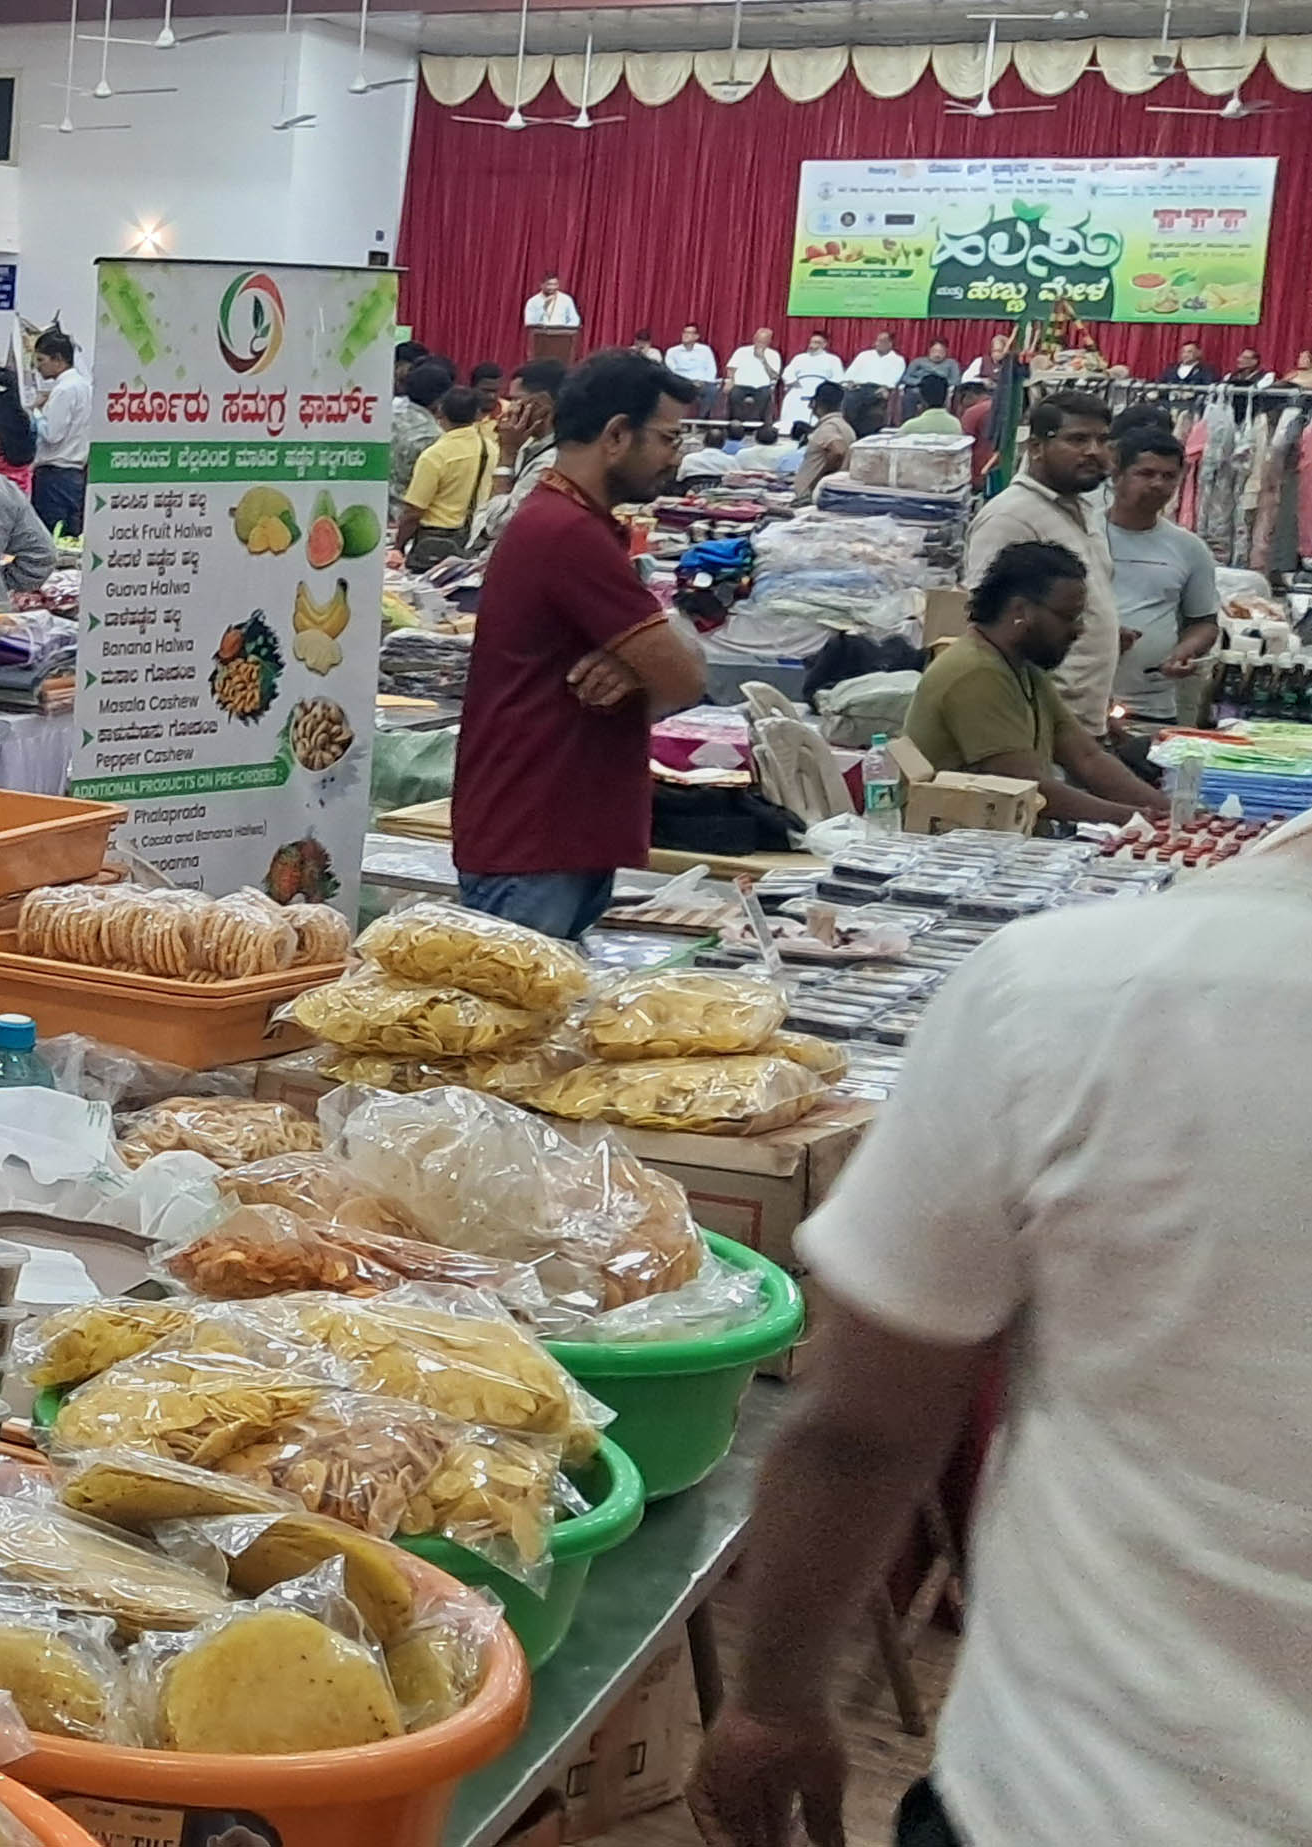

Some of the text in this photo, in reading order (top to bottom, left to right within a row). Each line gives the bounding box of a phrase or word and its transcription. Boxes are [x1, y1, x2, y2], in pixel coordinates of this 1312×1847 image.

[930, 205, 1123, 277] ಹಲಸು
[222, 385, 287, 437] ಸಮಗ್ರ
[109, 522, 213, 540] Jack Fruit Halwa
[106, 579, 190, 598] Guava Halwa
[103, 638, 194, 657] Banana Halwa
[99, 694, 199, 714] Masala Cashew
[96, 747, 194, 772] Pepper Cashew
[73, 781, 135, 798] ADDITIONAL
[139, 776, 195, 793] PRODUCTS
[197, 774, 213, 788] ON
[134, 804, 206, 825] Phalaprada
[175, 833, 194, 844] and
